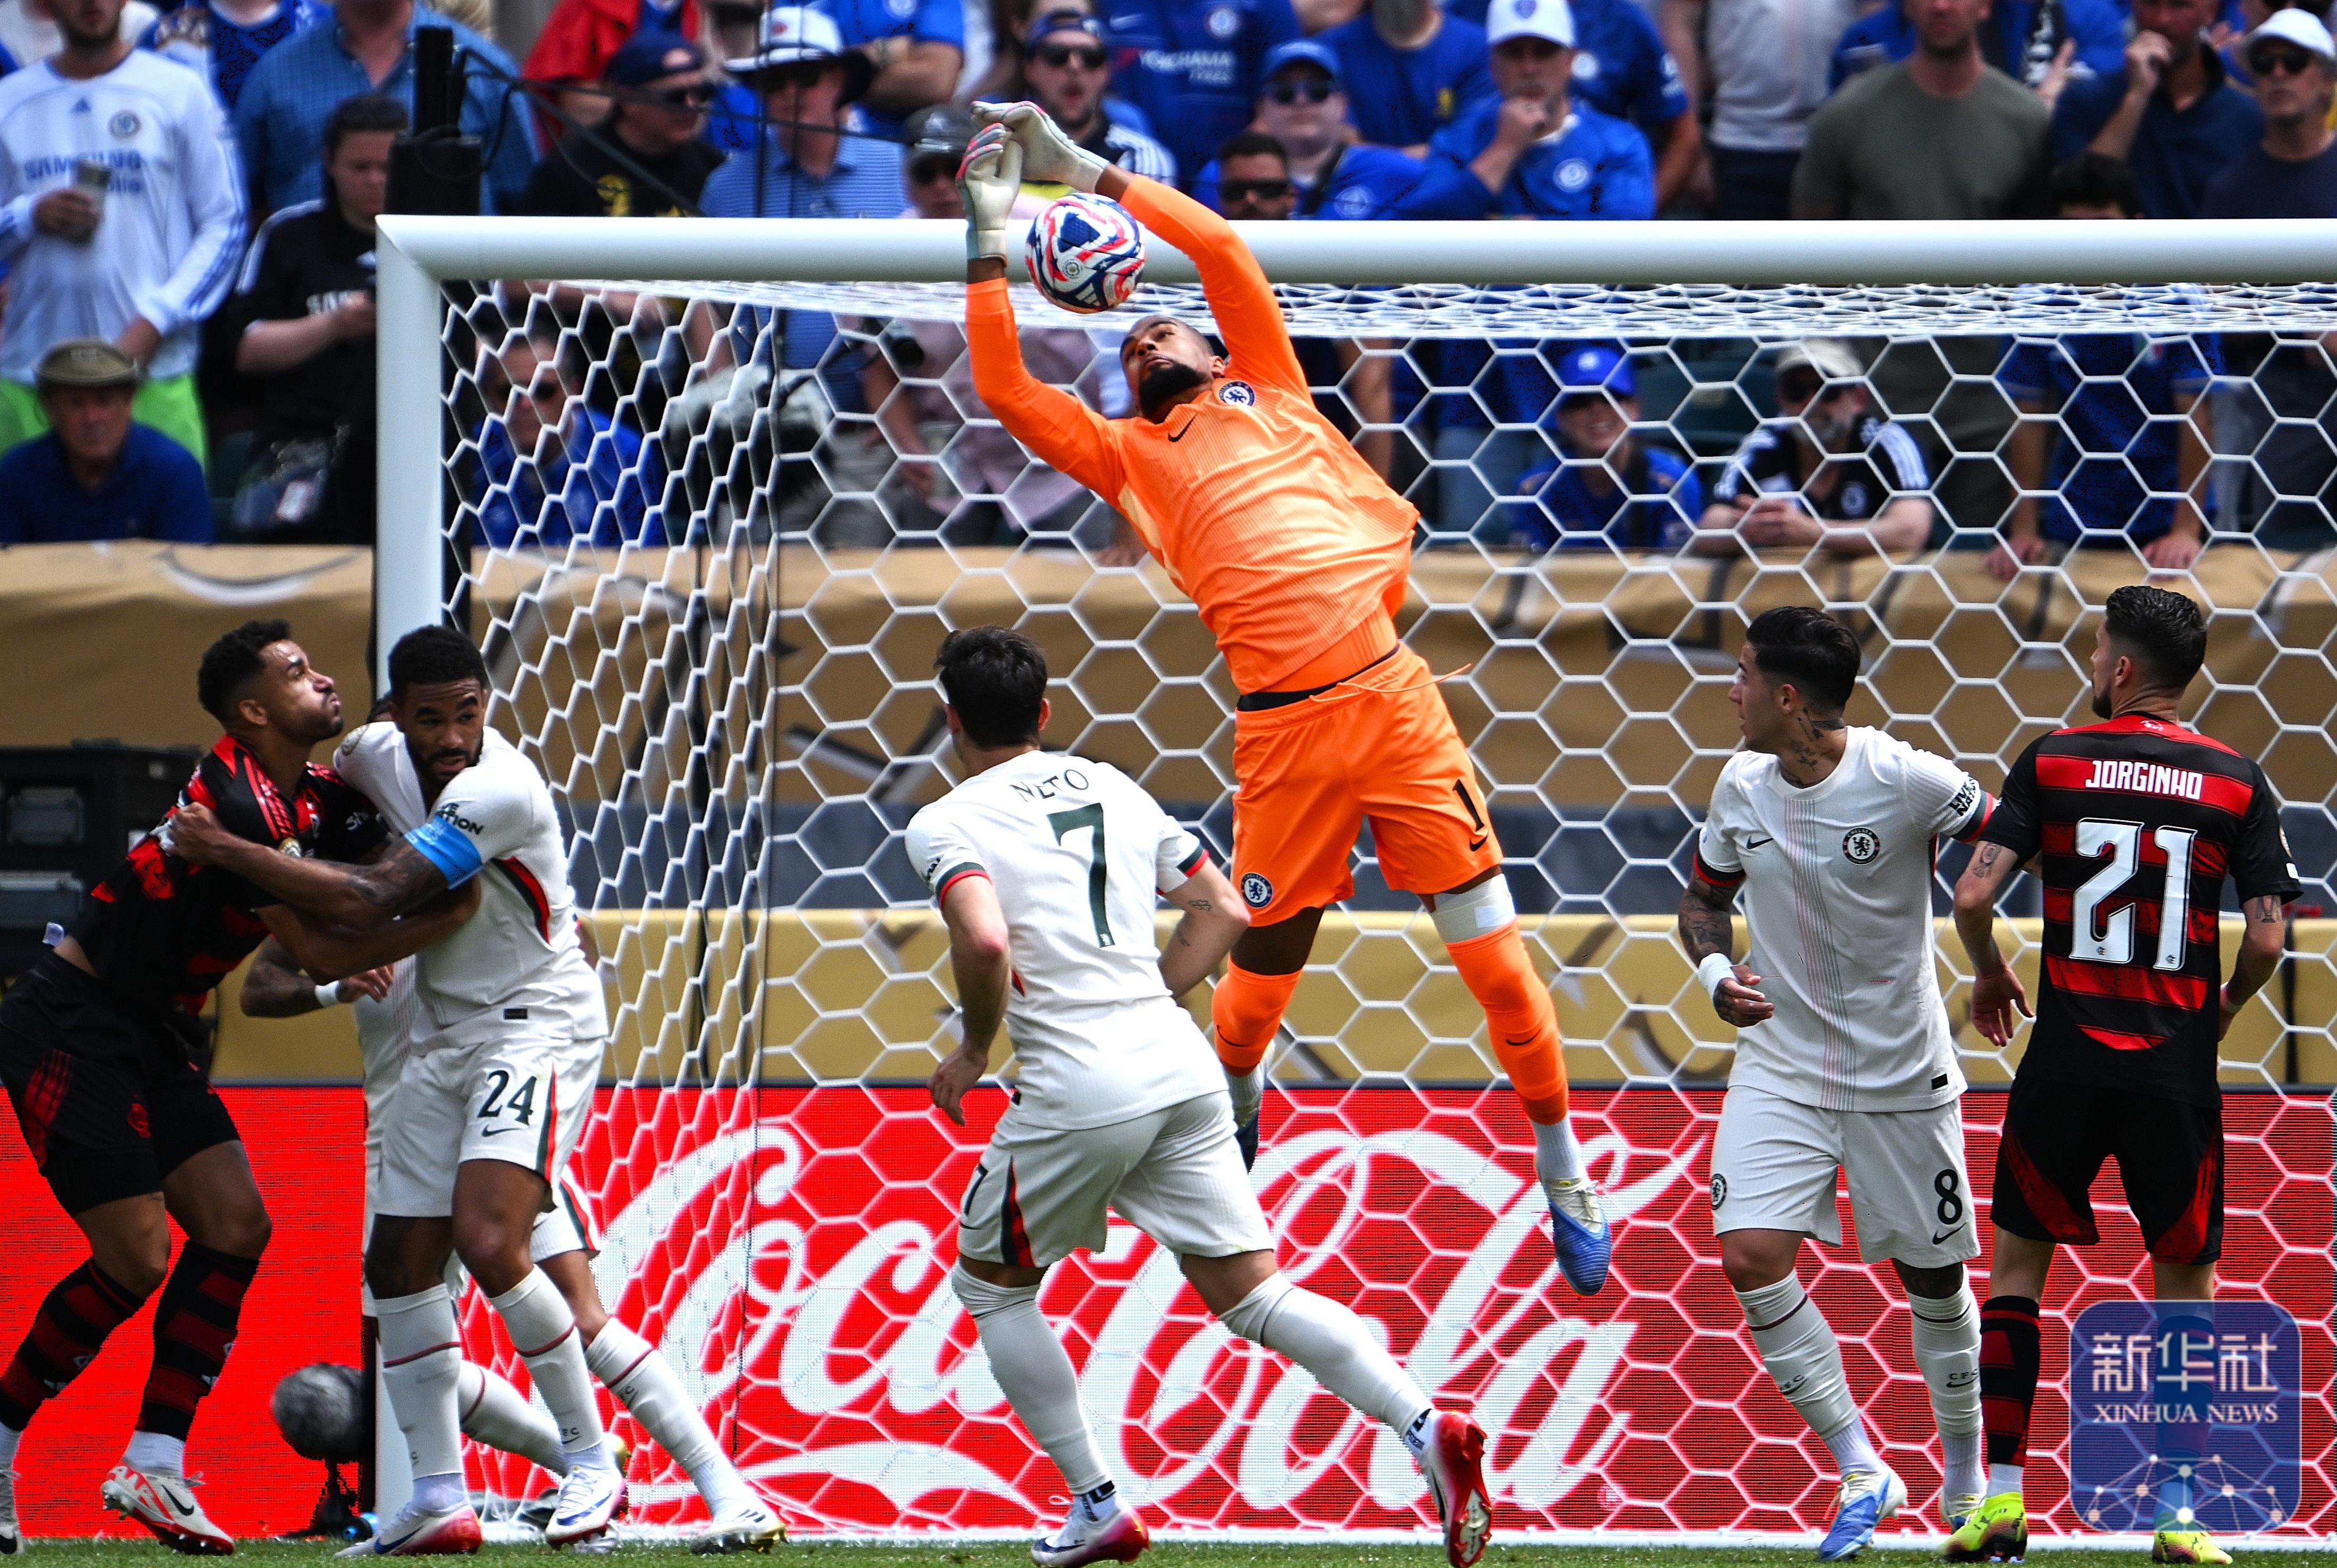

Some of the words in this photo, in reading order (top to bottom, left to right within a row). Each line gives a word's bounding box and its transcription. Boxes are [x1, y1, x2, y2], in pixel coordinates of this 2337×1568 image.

[1009, 769, 1089, 802] NETO
[1452, 779, 1484, 832] 1
[2085, 760, 2203, 800] JORGINHO
[1046, 802, 1116, 948] 7
[2068, 817, 2198, 971] 21
[477, 1070, 537, 1126] 24
[1934, 1169, 1963, 1225] 8
